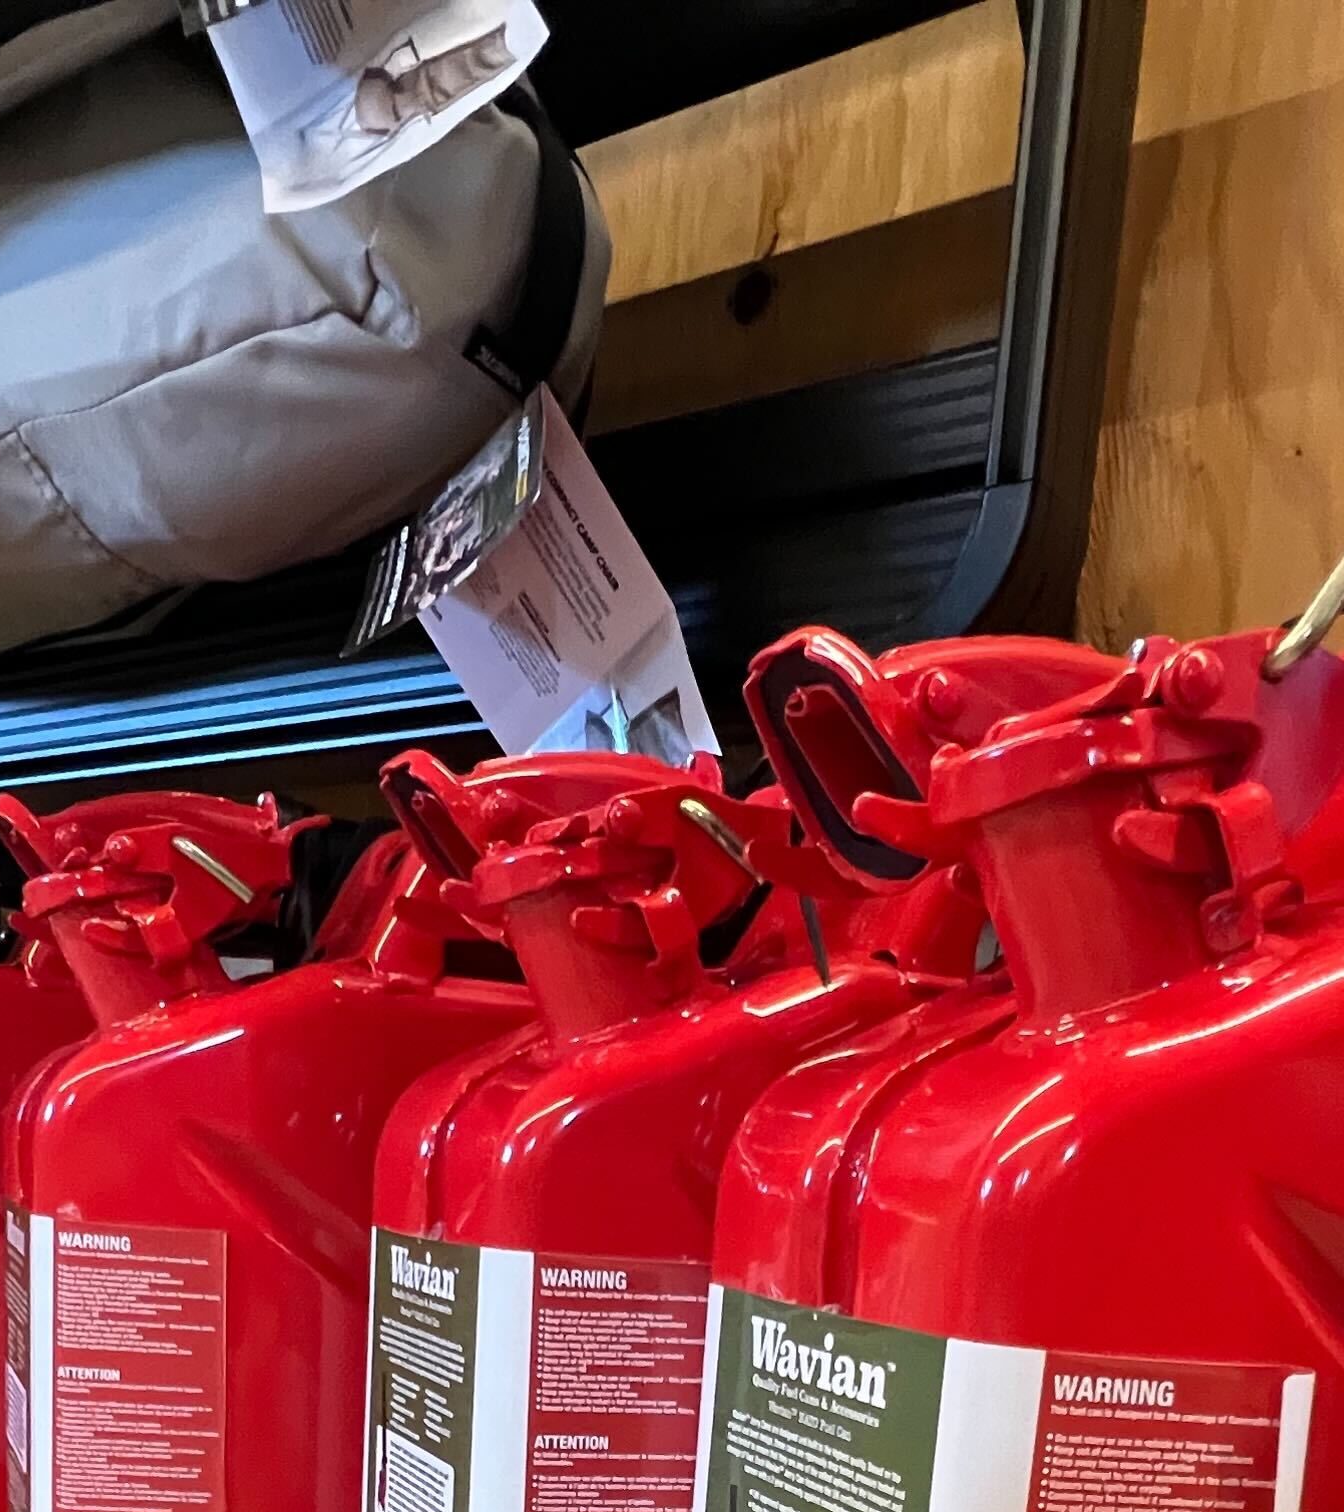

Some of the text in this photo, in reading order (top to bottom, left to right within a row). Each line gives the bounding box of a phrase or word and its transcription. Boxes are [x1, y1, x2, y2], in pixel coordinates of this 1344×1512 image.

[57, 1231, 132, 1252] WARNING
[391, 1244, 455, 1302] Wavian
[540, 1268, 627, 1290] WARNING
[751, 1315, 887, 1410] Wavian
[57, 1366, 121, 1382] ATTENTION
[1054, 1374, 1175, 1407] WARNING
[534, 1435, 609, 1451] ATTENTION
